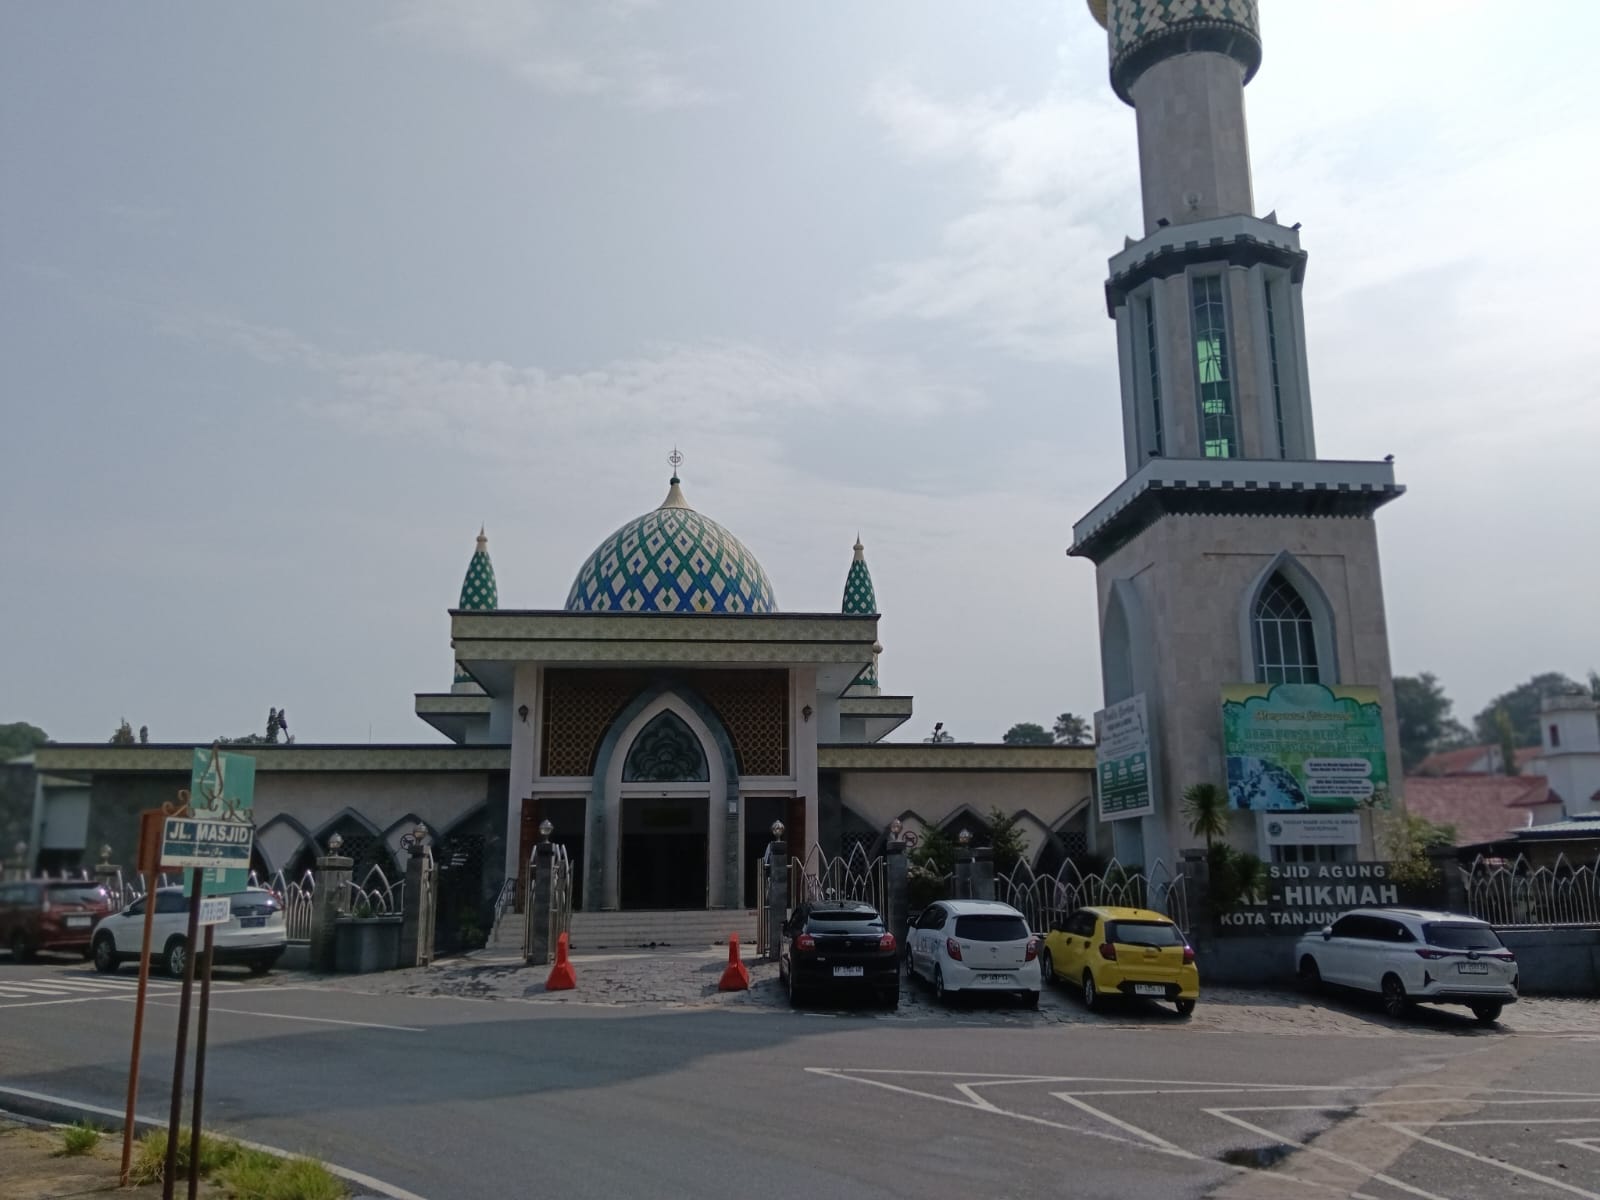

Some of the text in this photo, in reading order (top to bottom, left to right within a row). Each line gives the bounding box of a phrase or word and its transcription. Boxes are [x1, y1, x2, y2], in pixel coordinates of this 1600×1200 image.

[169, 822, 249, 842] JL. MASJID
[1270, 865, 1385, 878] SJID AGUNG
[1220, 912, 1266, 925] KOTA
